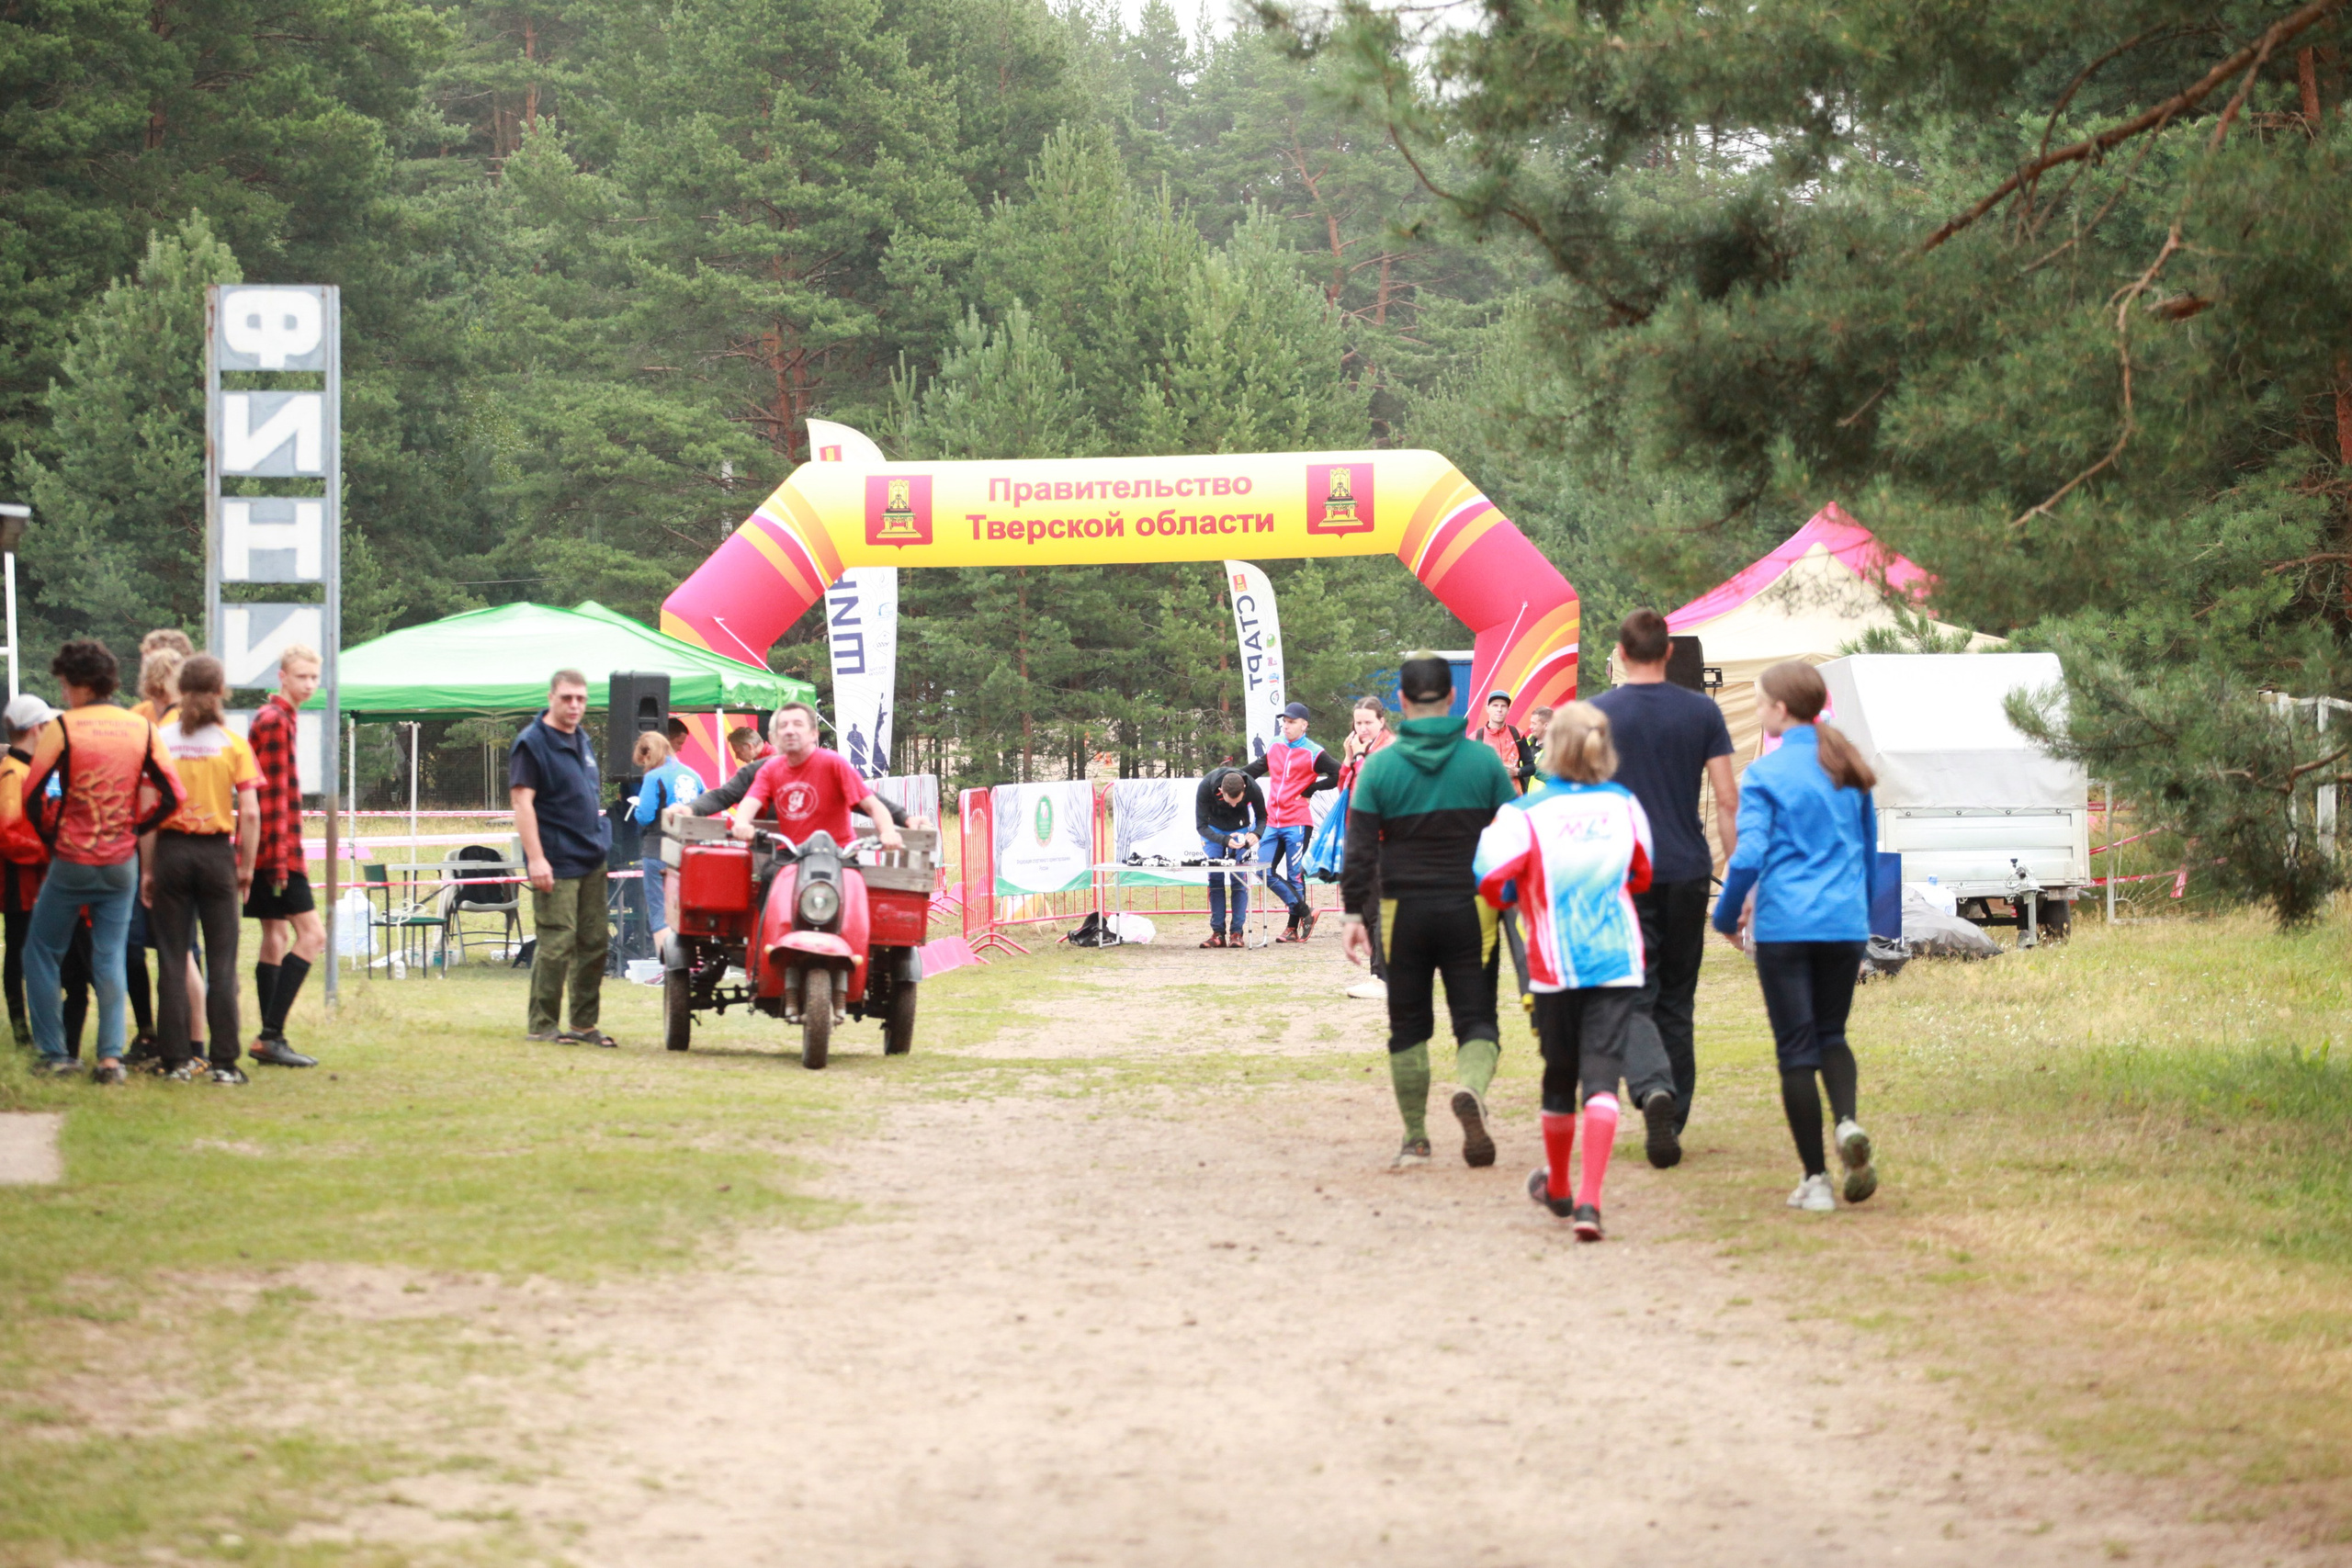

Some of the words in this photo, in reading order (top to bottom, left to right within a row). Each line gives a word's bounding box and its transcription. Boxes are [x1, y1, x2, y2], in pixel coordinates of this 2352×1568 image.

[989, 476, 1253, 508] Правительство
[966, 511, 1125, 545] Тверской
[1136, 509, 1275, 536] области
